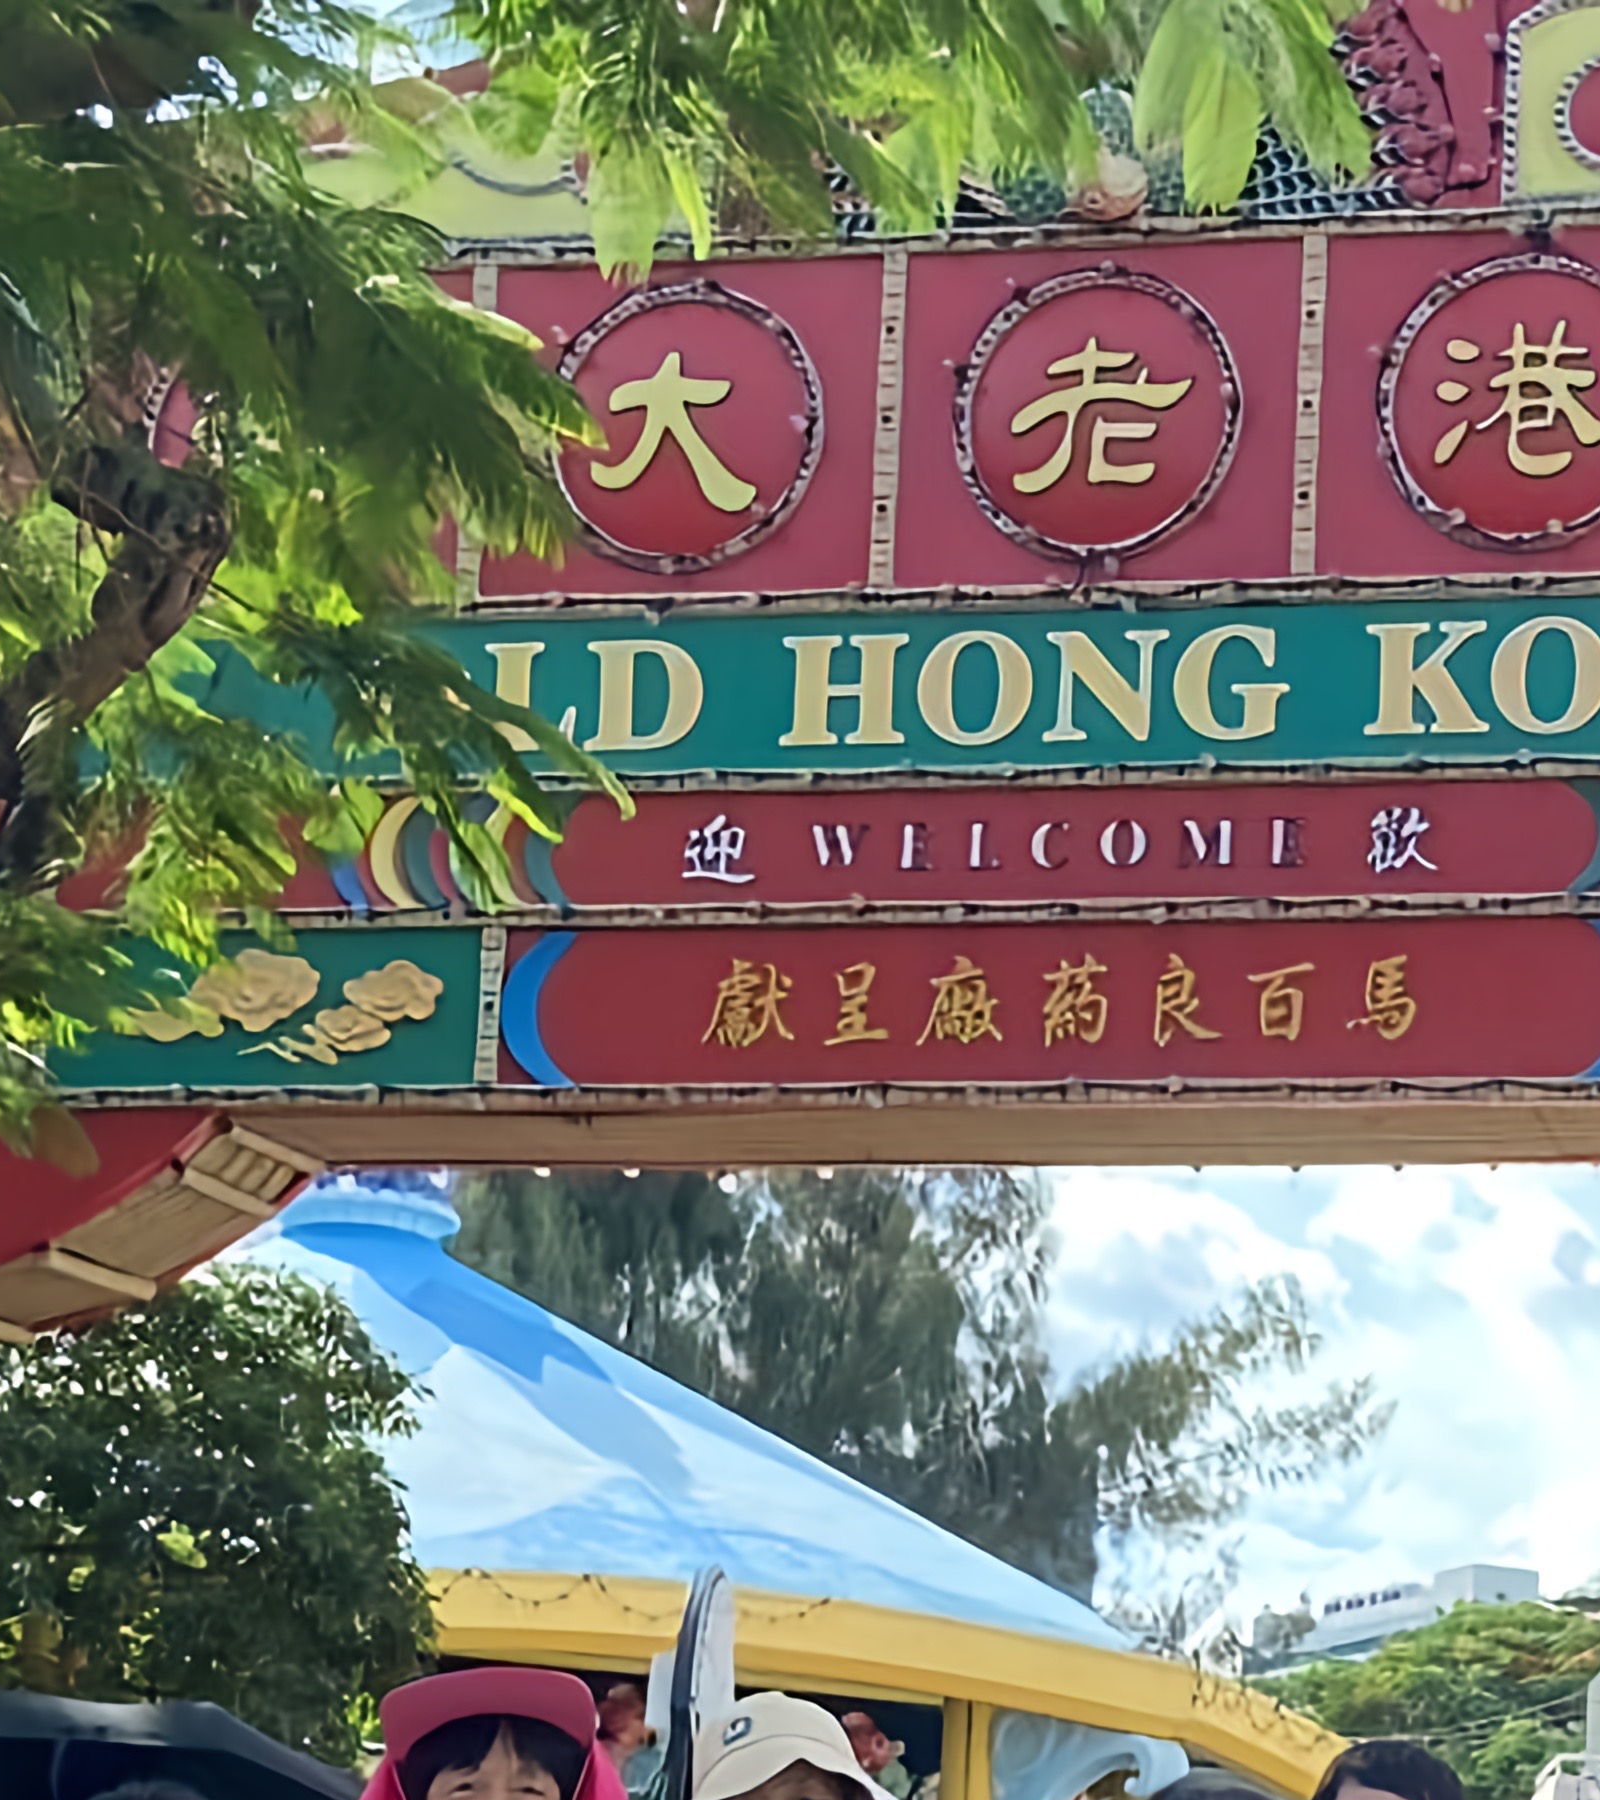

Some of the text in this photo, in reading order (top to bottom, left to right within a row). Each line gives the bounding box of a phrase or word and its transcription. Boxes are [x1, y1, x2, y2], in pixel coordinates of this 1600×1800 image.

[484, 638, 704, 753] LD
[778, 622, 1291, 748] HONG
[681, 813, 756, 885] 迎
[811, 817, 1308, 871] WELCOME
